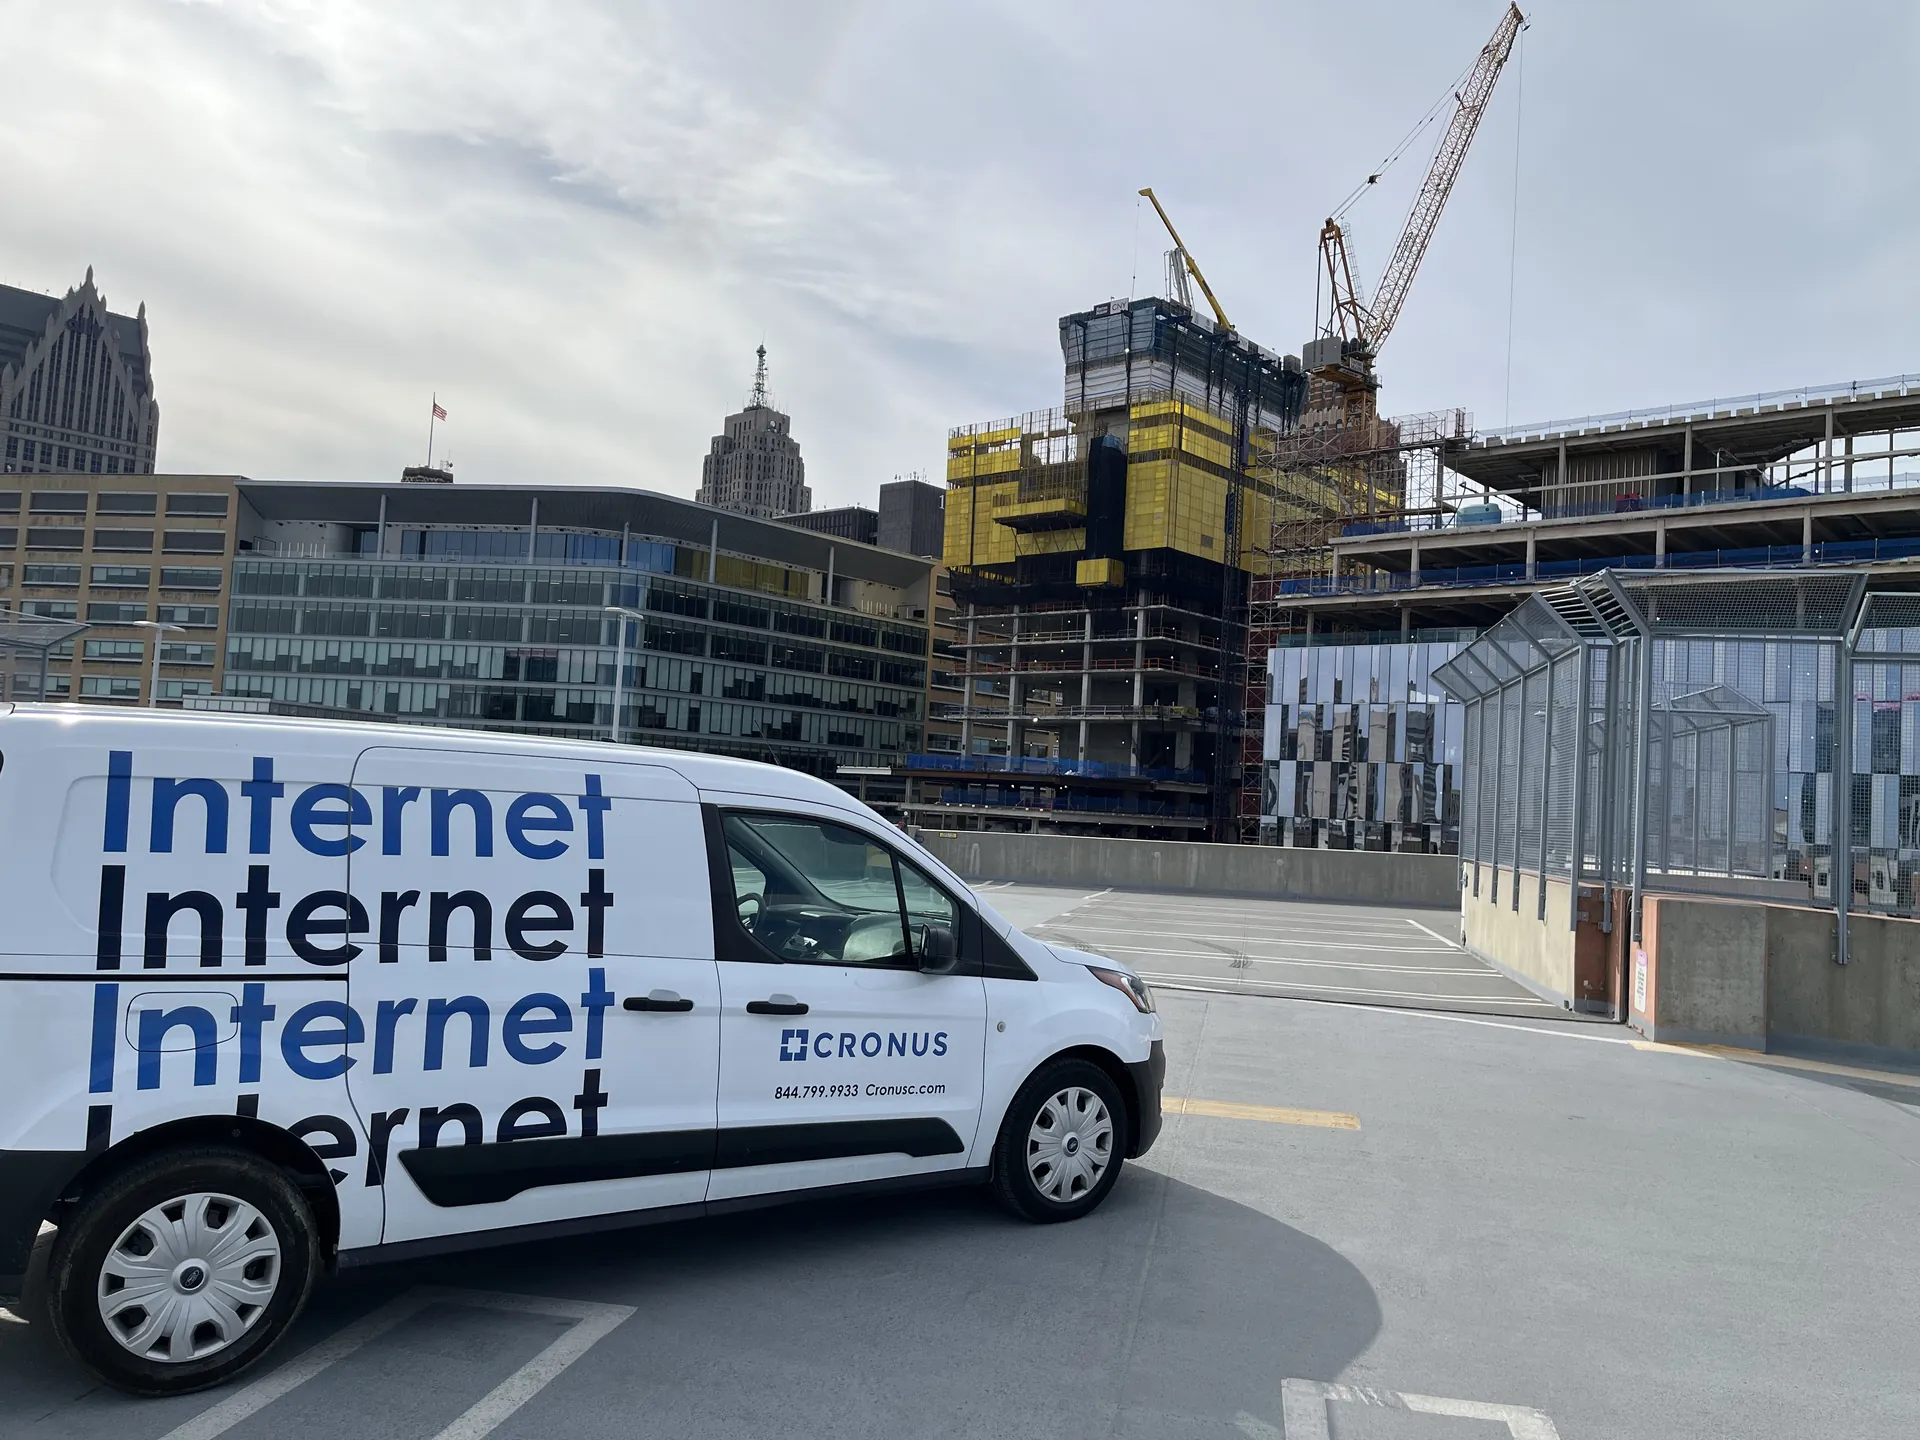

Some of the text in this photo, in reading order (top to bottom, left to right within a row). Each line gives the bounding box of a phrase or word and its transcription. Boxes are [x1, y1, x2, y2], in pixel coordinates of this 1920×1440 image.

[103, 750, 611, 860] Internet
[97, 865, 613, 970] Internet
[88, 967, 615, 1093] Internet
[813, 1031, 949, 1058] CRONUS
[86, 1069, 608, 1187] ernet
[774, 1083, 946, 1100] 844.799.9933 Cronusc.com
